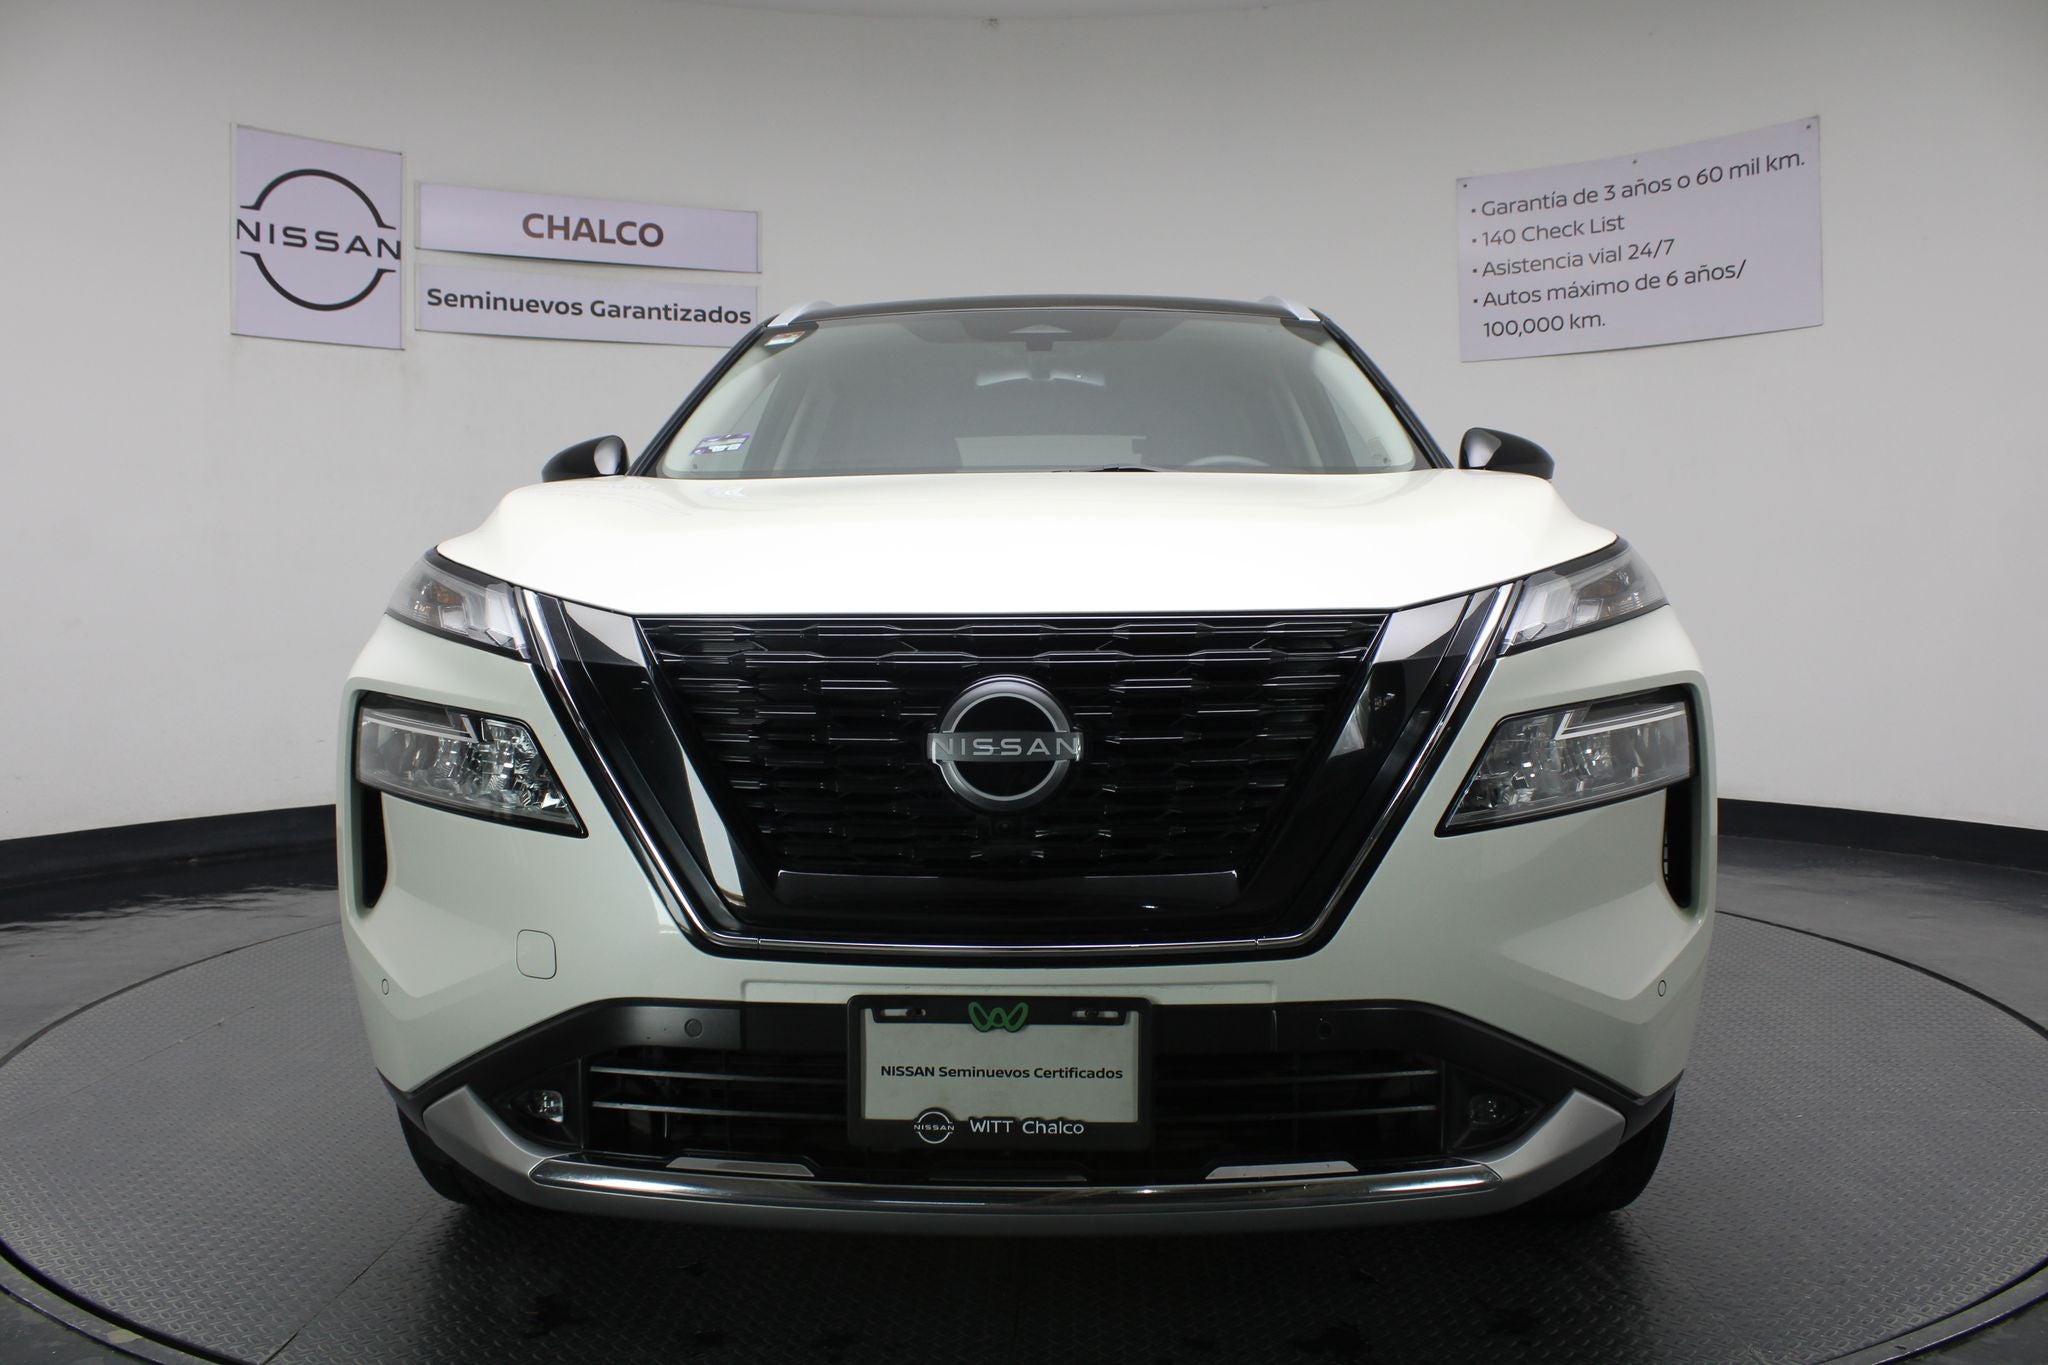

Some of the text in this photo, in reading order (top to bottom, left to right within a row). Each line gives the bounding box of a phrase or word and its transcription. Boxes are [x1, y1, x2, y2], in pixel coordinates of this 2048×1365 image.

[1482, 152, 1805, 216] Garantía de 3 años o 60 mil km.
[237, 218, 401, 260] NISSAN
[522, 213, 664, 247] CHALCO
[1483, 215, 1624, 246] 140 Check List
[1483, 239, 1675, 277] Asistencia vial 24/7
[1483, 260, 1746, 307] Autos máximo de 6 años/
[427, 288, 751, 324] Seminuevos Garantizados
[1483, 313, 1605, 337] 100,000 km.
[932, 738, 1079, 755] NISSAN
[881, 1065, 1123, 1079] NISSAN Seminuevos Certificados
[913, 1123, 955, 1132] NISSAN
[969, 1119, 1085, 1135] WITT Chalco
